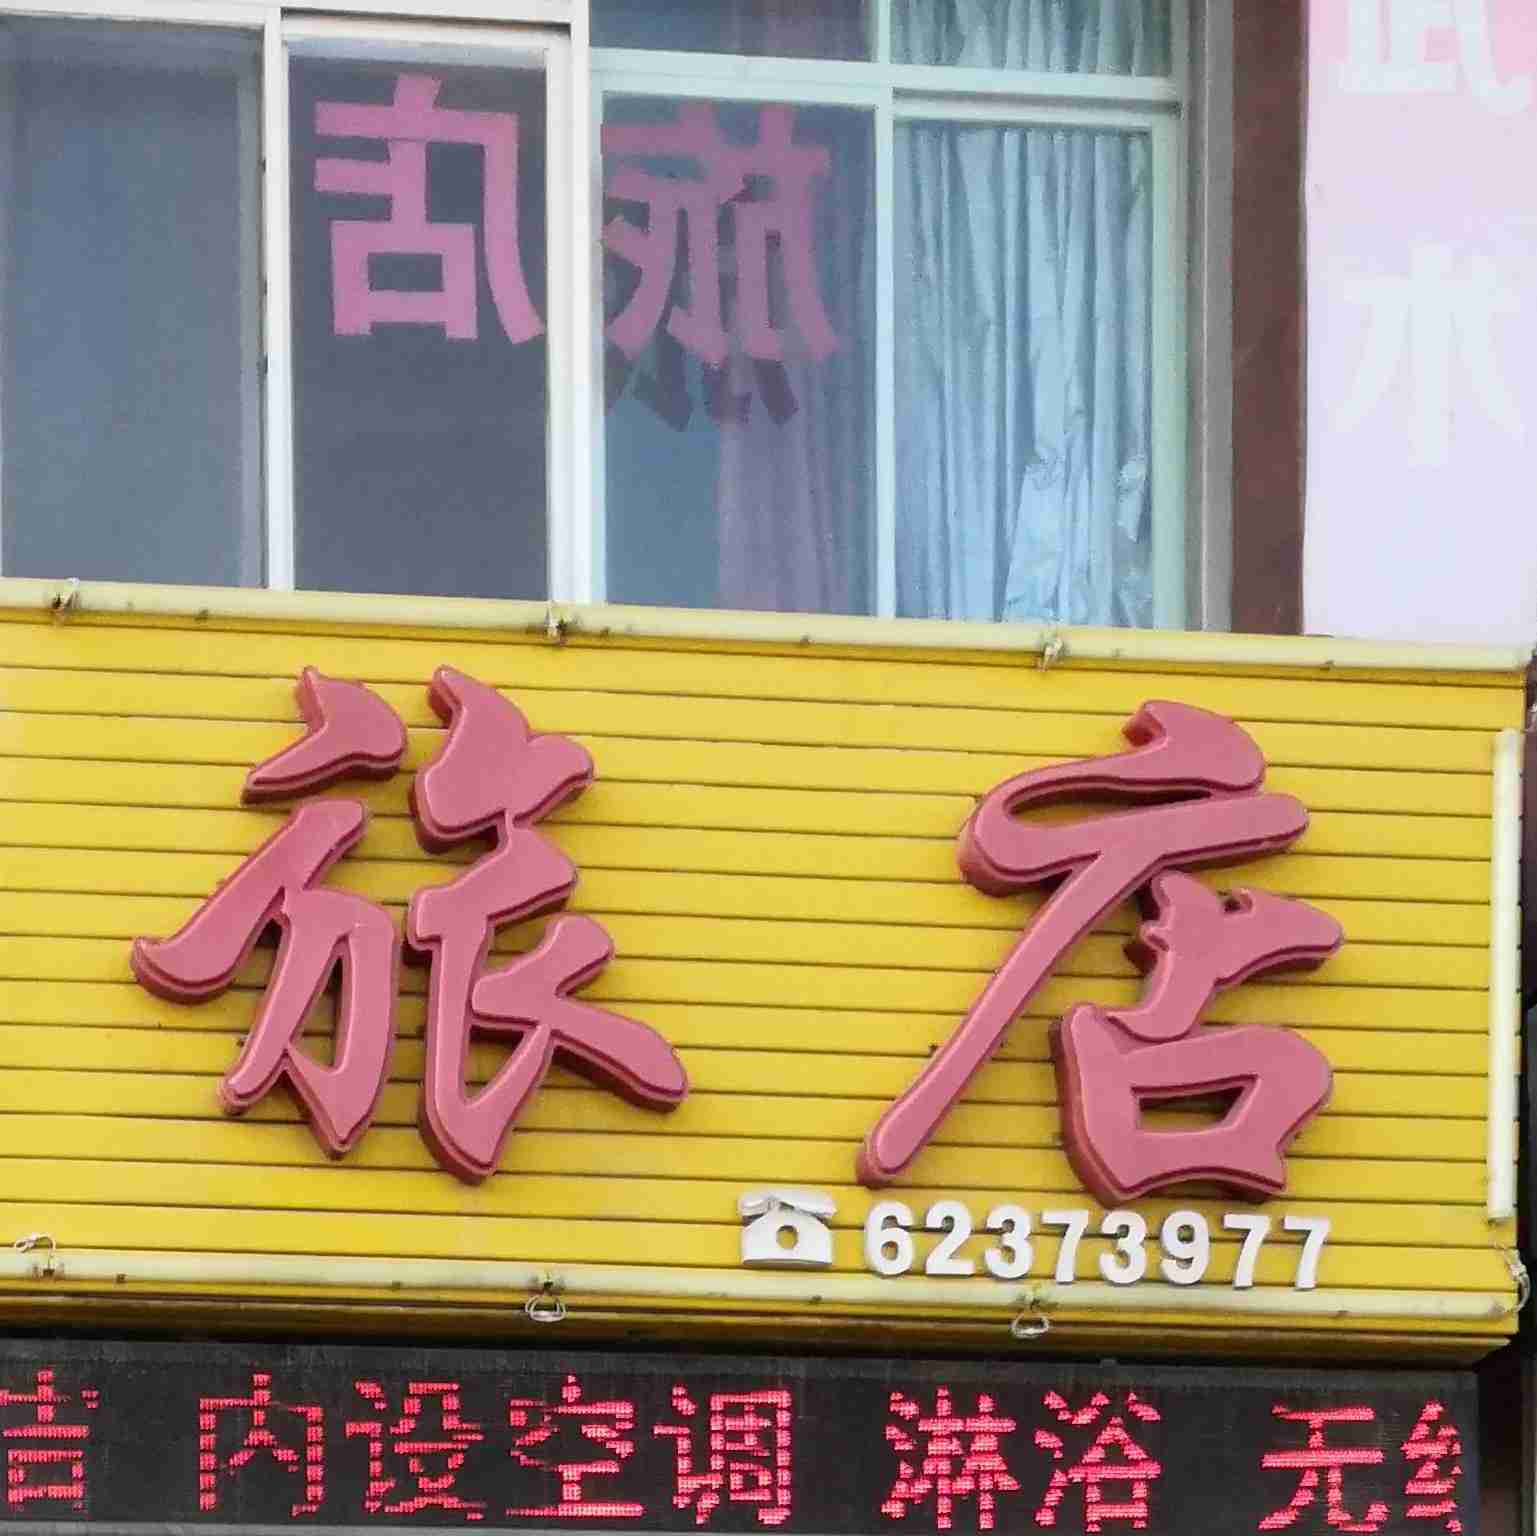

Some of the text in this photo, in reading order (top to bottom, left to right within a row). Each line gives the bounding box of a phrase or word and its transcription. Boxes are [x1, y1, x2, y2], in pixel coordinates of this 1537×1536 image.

[865, 1198, 1332, 1291] 62373977
[197, 1372, 794, 1526] 内设空调
[880, 1387, 1163, 1533] 淋浴
